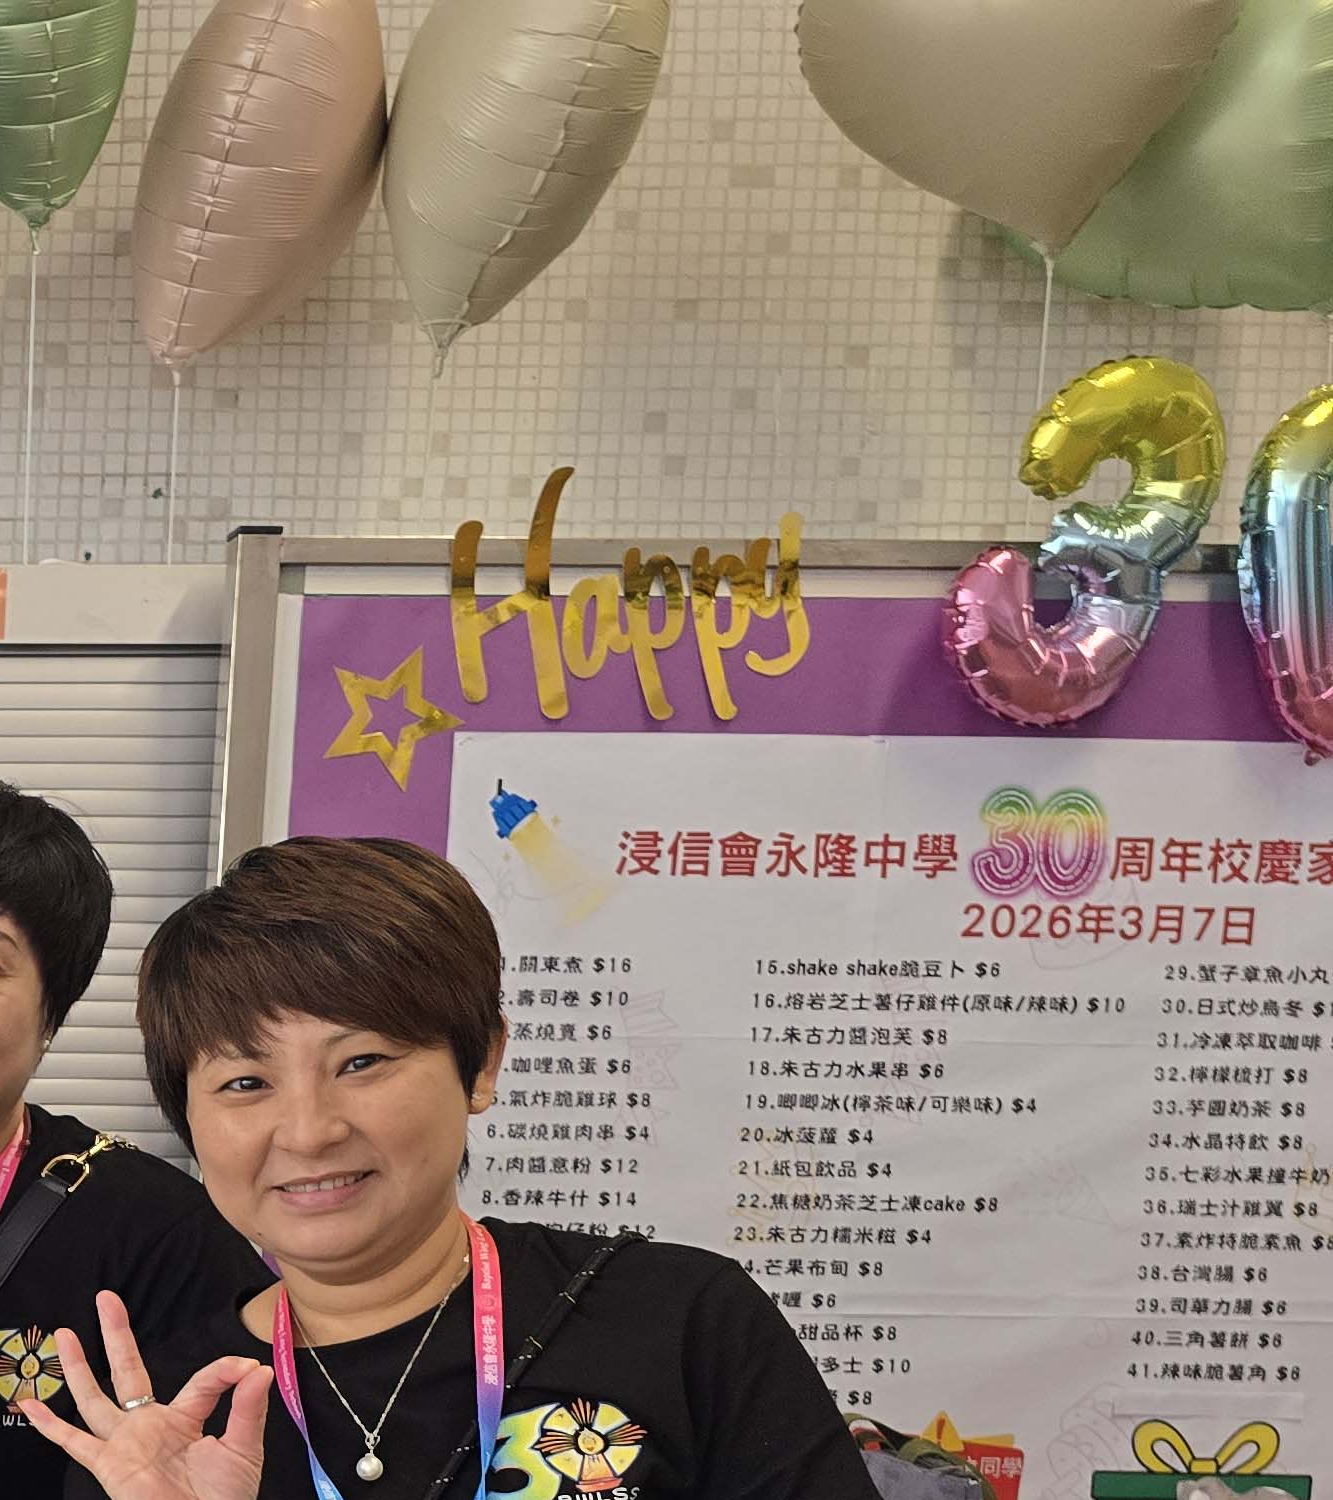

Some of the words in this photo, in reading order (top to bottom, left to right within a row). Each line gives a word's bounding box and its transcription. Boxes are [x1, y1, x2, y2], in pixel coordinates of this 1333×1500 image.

[449, 465, 811, 721] Happy
[961, 902, 1255, 946] 2026年3月7日
[593, 958, 631, 973] $16
[756, 959, 838, 977] 15.shake
[976, 963, 1000, 978] $6
[590, 992, 629, 1007] $10
[1087, 999, 1125, 1014] $10
[507, 1023, 578, 1041] .蒸燒賣
[587, 1025, 612, 1041] $6
[922, 1029, 948, 1046] $8
[919, 1064, 944, 1079] $6
[1284, 1069, 1308, 1085] $8
[627, 1093, 651, 1108] $8
[1012, 1096, 1036, 1113] $4
[1281, 1102, 1305, 1118] $8
[626, 1126, 649, 1141] $4
[848, 1129, 873, 1145] $4
[1278, 1134, 1303, 1150] $8
[600, 1159, 638, 1174] $12
[739, 1161, 857, 1178] 21.紙包飲品
[867, 1163, 892, 1178] $4
[598, 1192, 636, 1206] $14
[974, 1197, 998, 1212] $8
[1293, 1202, 1318, 1217] $8
[906, 1229, 931, 1244] $4
[745, 1259, 848, 1277] 4.芒果布甸
[859, 1261, 883, 1277] $8
[811, 1294, 836, 1308] $6
[872, 1326, 897, 1341] $8
[872, 1359, 911, 1373] $10
[848, 1391, 872, 1405] $8
